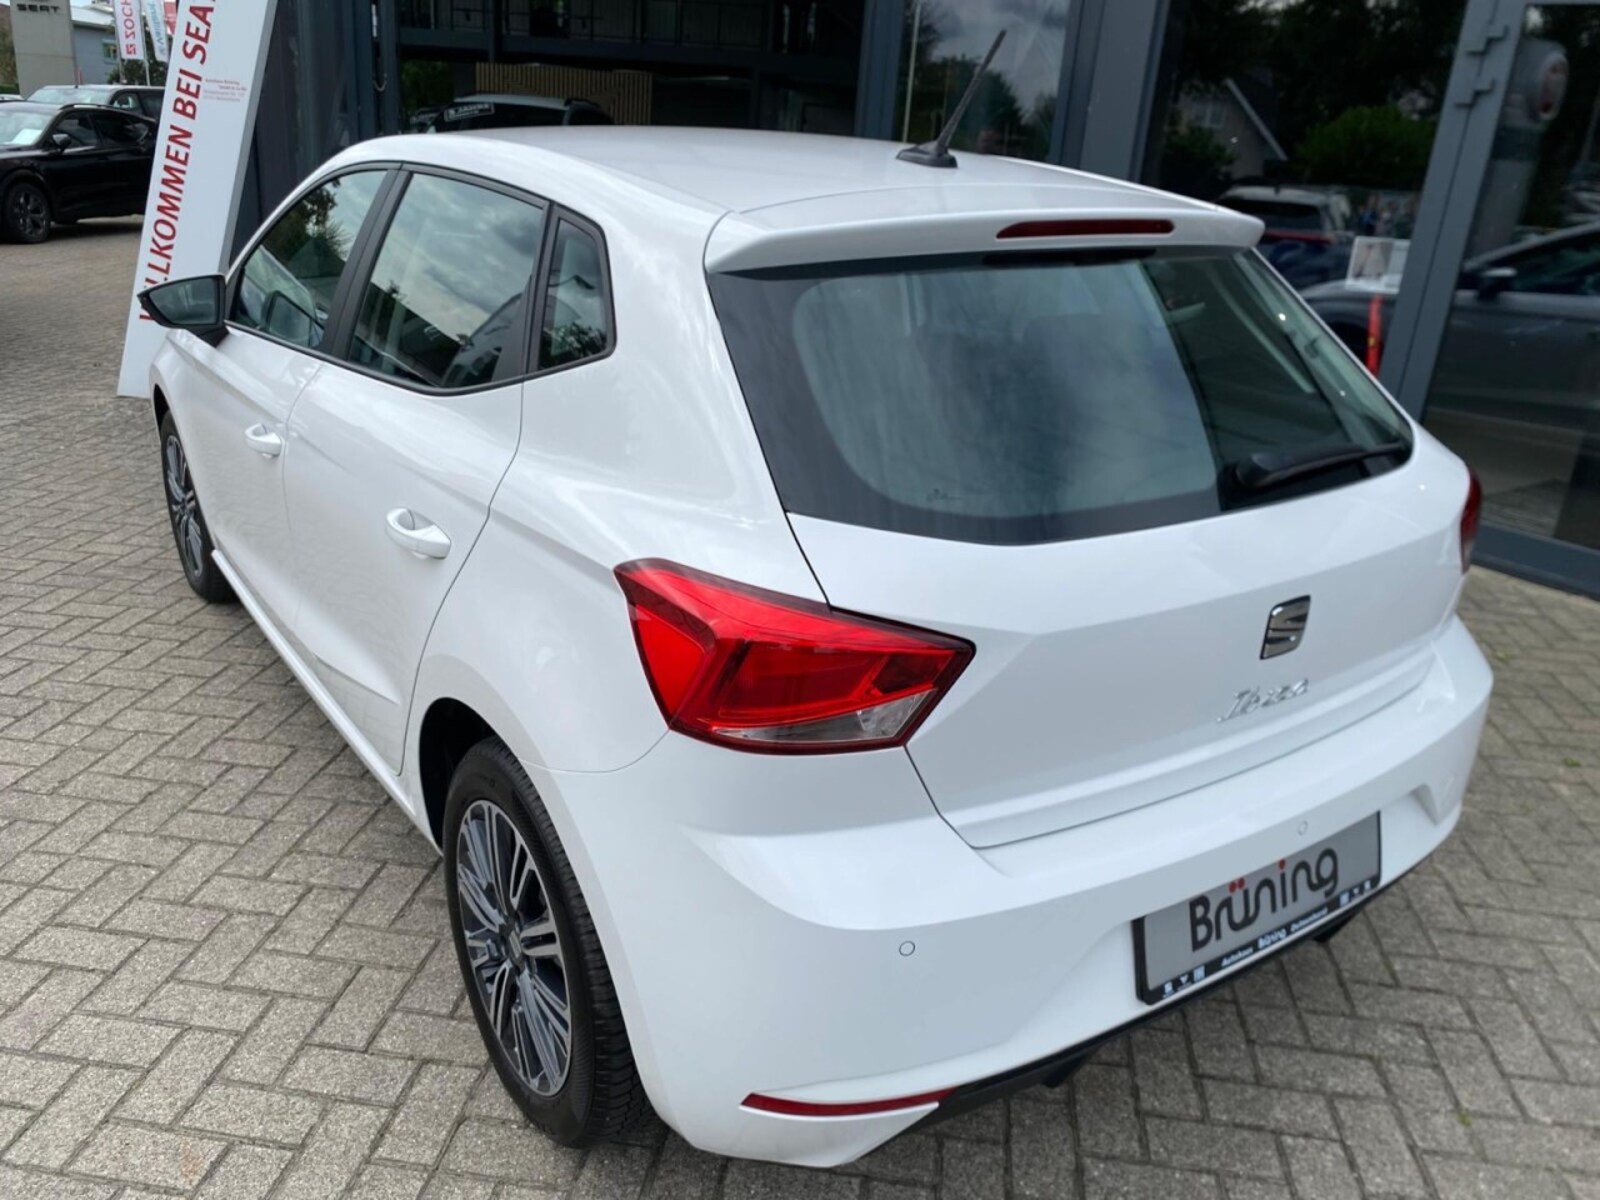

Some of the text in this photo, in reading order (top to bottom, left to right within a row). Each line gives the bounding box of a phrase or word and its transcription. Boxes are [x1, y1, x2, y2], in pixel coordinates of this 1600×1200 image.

[17, 4, 60, 14] SEAT
[139, 0, 215, 321] LLKOMMEN BEI SEA
[1189, 848, 1338, 952] Brüning
